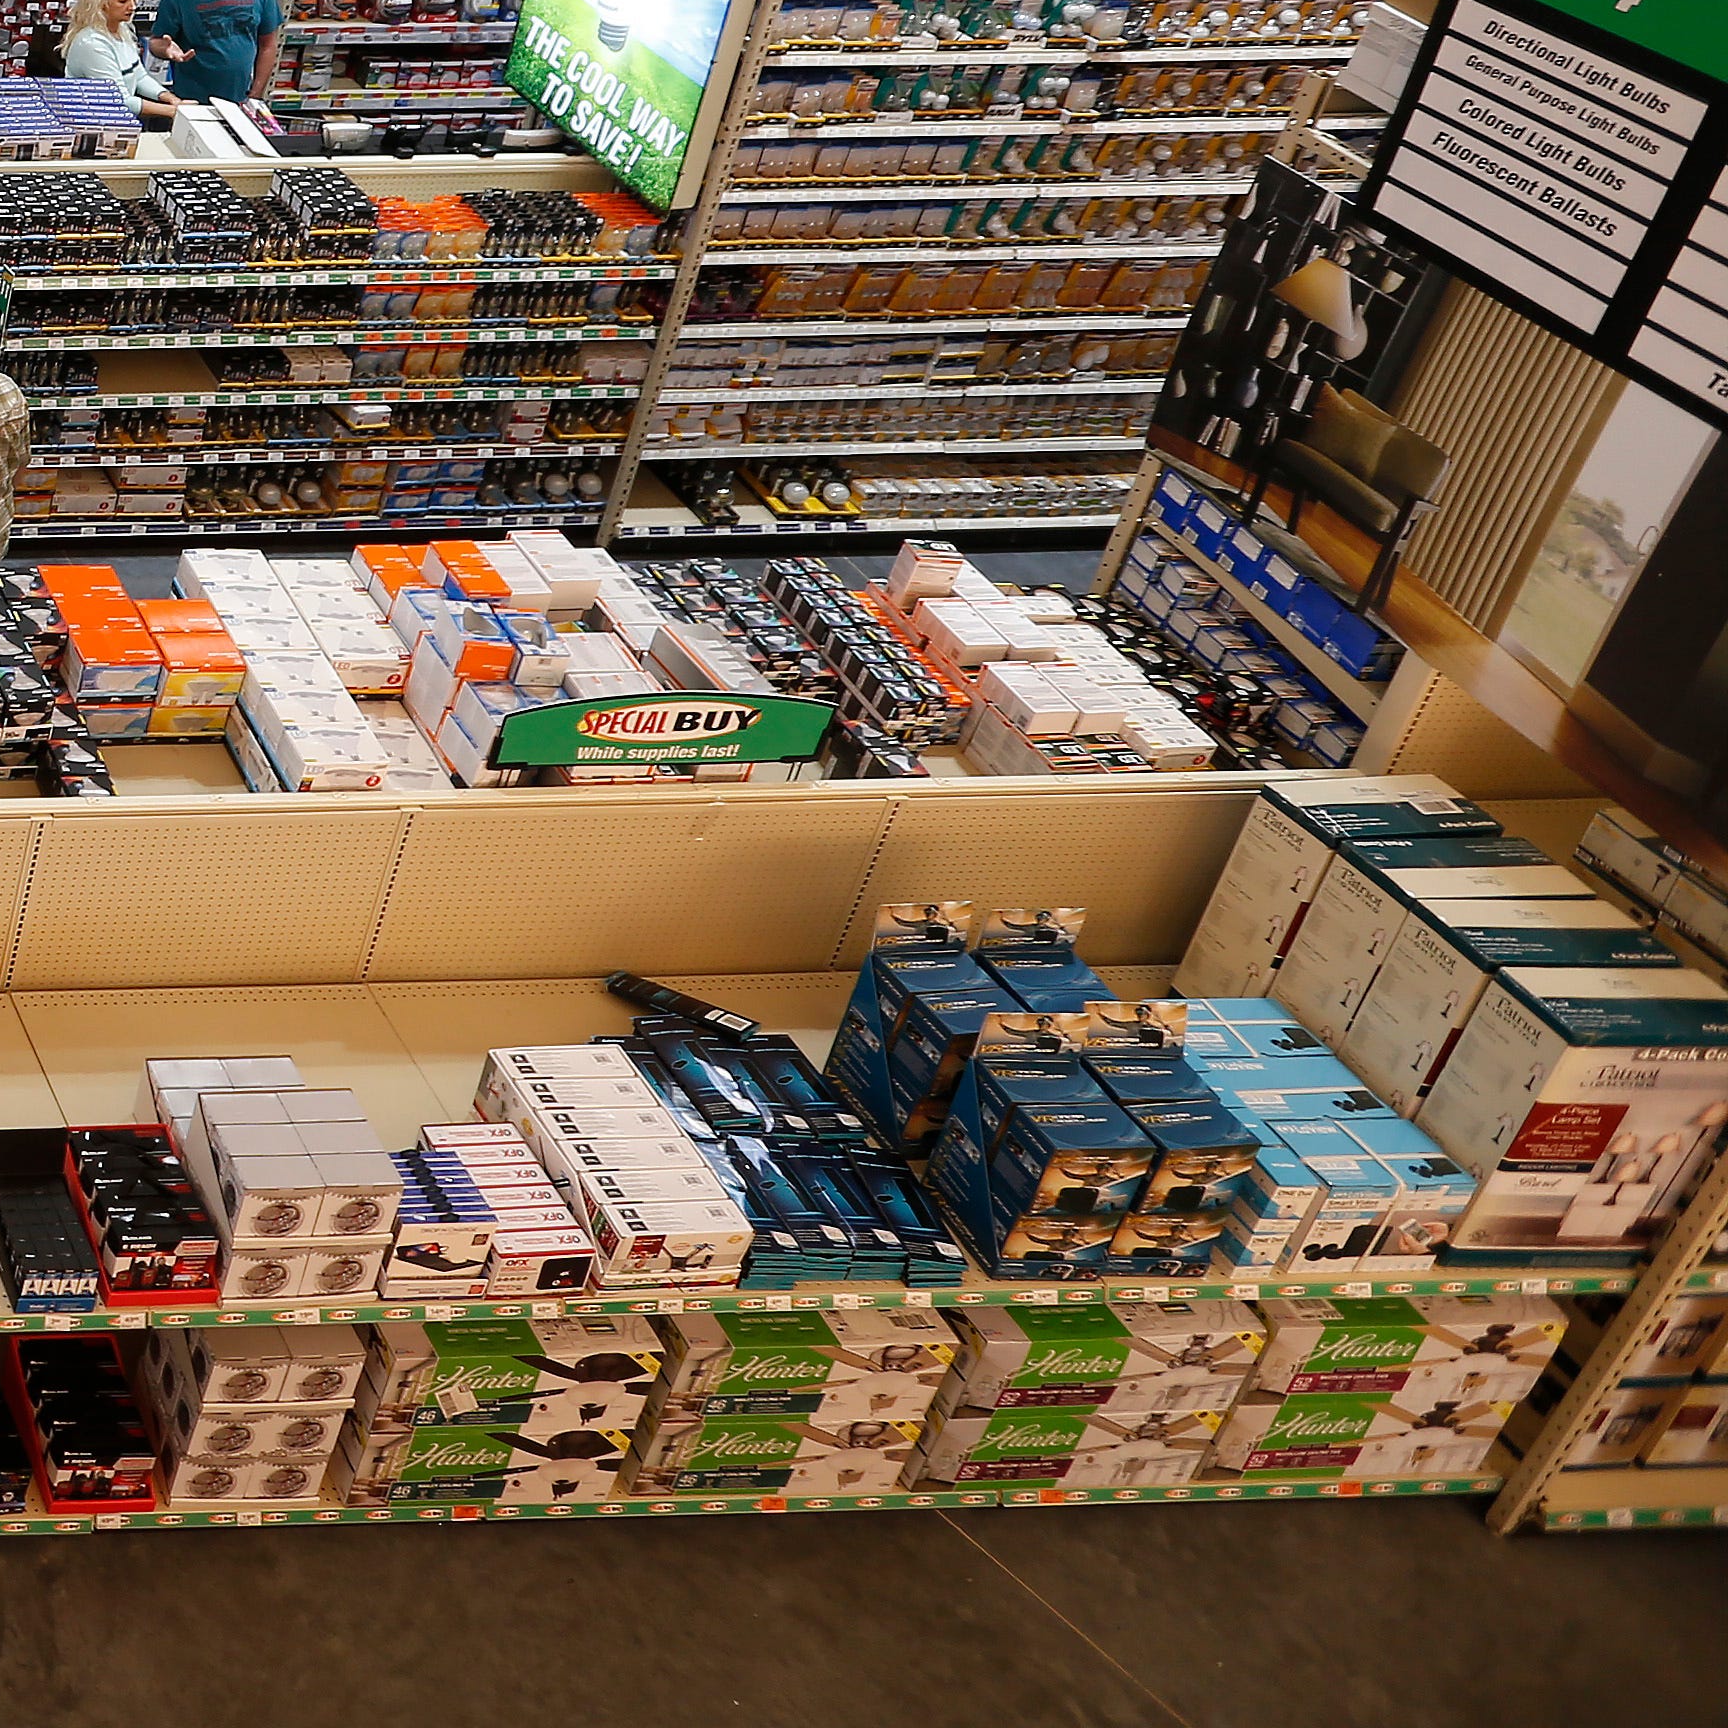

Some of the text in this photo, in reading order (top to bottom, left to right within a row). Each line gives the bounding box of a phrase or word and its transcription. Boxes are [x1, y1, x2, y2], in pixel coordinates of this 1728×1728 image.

[524, 15, 686, 158] THE COOL WAY
[1465, 54, 1661, 156] General Purpose Light Bulbs
[1483, 20, 1671, 115] Directional Light Bulbs
[541, 72, 643, 174] TO SAVE!
[1458, 98, 1626, 191] Colored Light Bulbs
[1432, 131, 1619, 238] Fluorescent Ballasts
[578, 744, 740, 761] While supplies last!
[580, 706, 762, 734] SPECIAL BUY
[1639, 1048, 1697, 1062] 4-Pack
[719, 1355, 829, 1381] Hunter
[685, 1432, 799, 1458] Hunter
